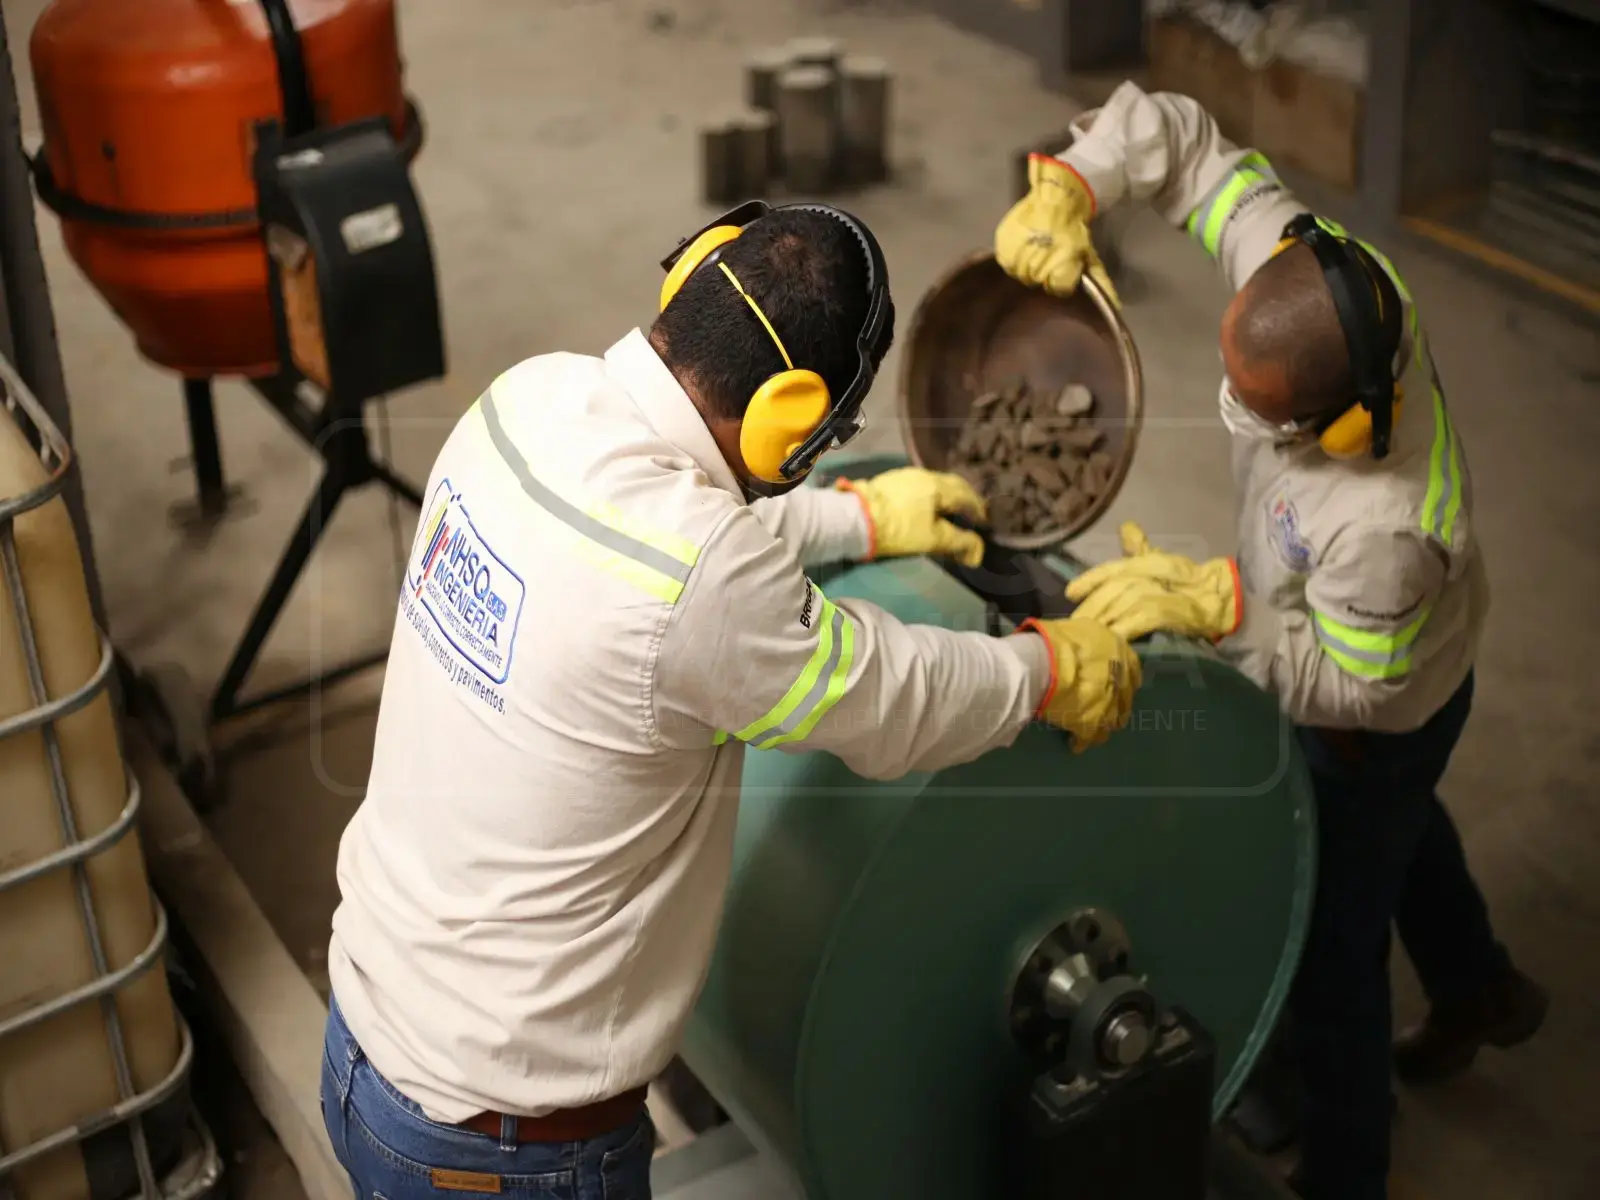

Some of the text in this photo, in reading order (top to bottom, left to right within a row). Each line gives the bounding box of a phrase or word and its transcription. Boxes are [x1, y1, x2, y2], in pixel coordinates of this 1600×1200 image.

[444, 527, 490, 604] NHSQ
[434, 559, 498, 648] INGENIERIA
[450, 662, 459, 682] y
[459, 624, 503, 669] CORRECTAMENTE
